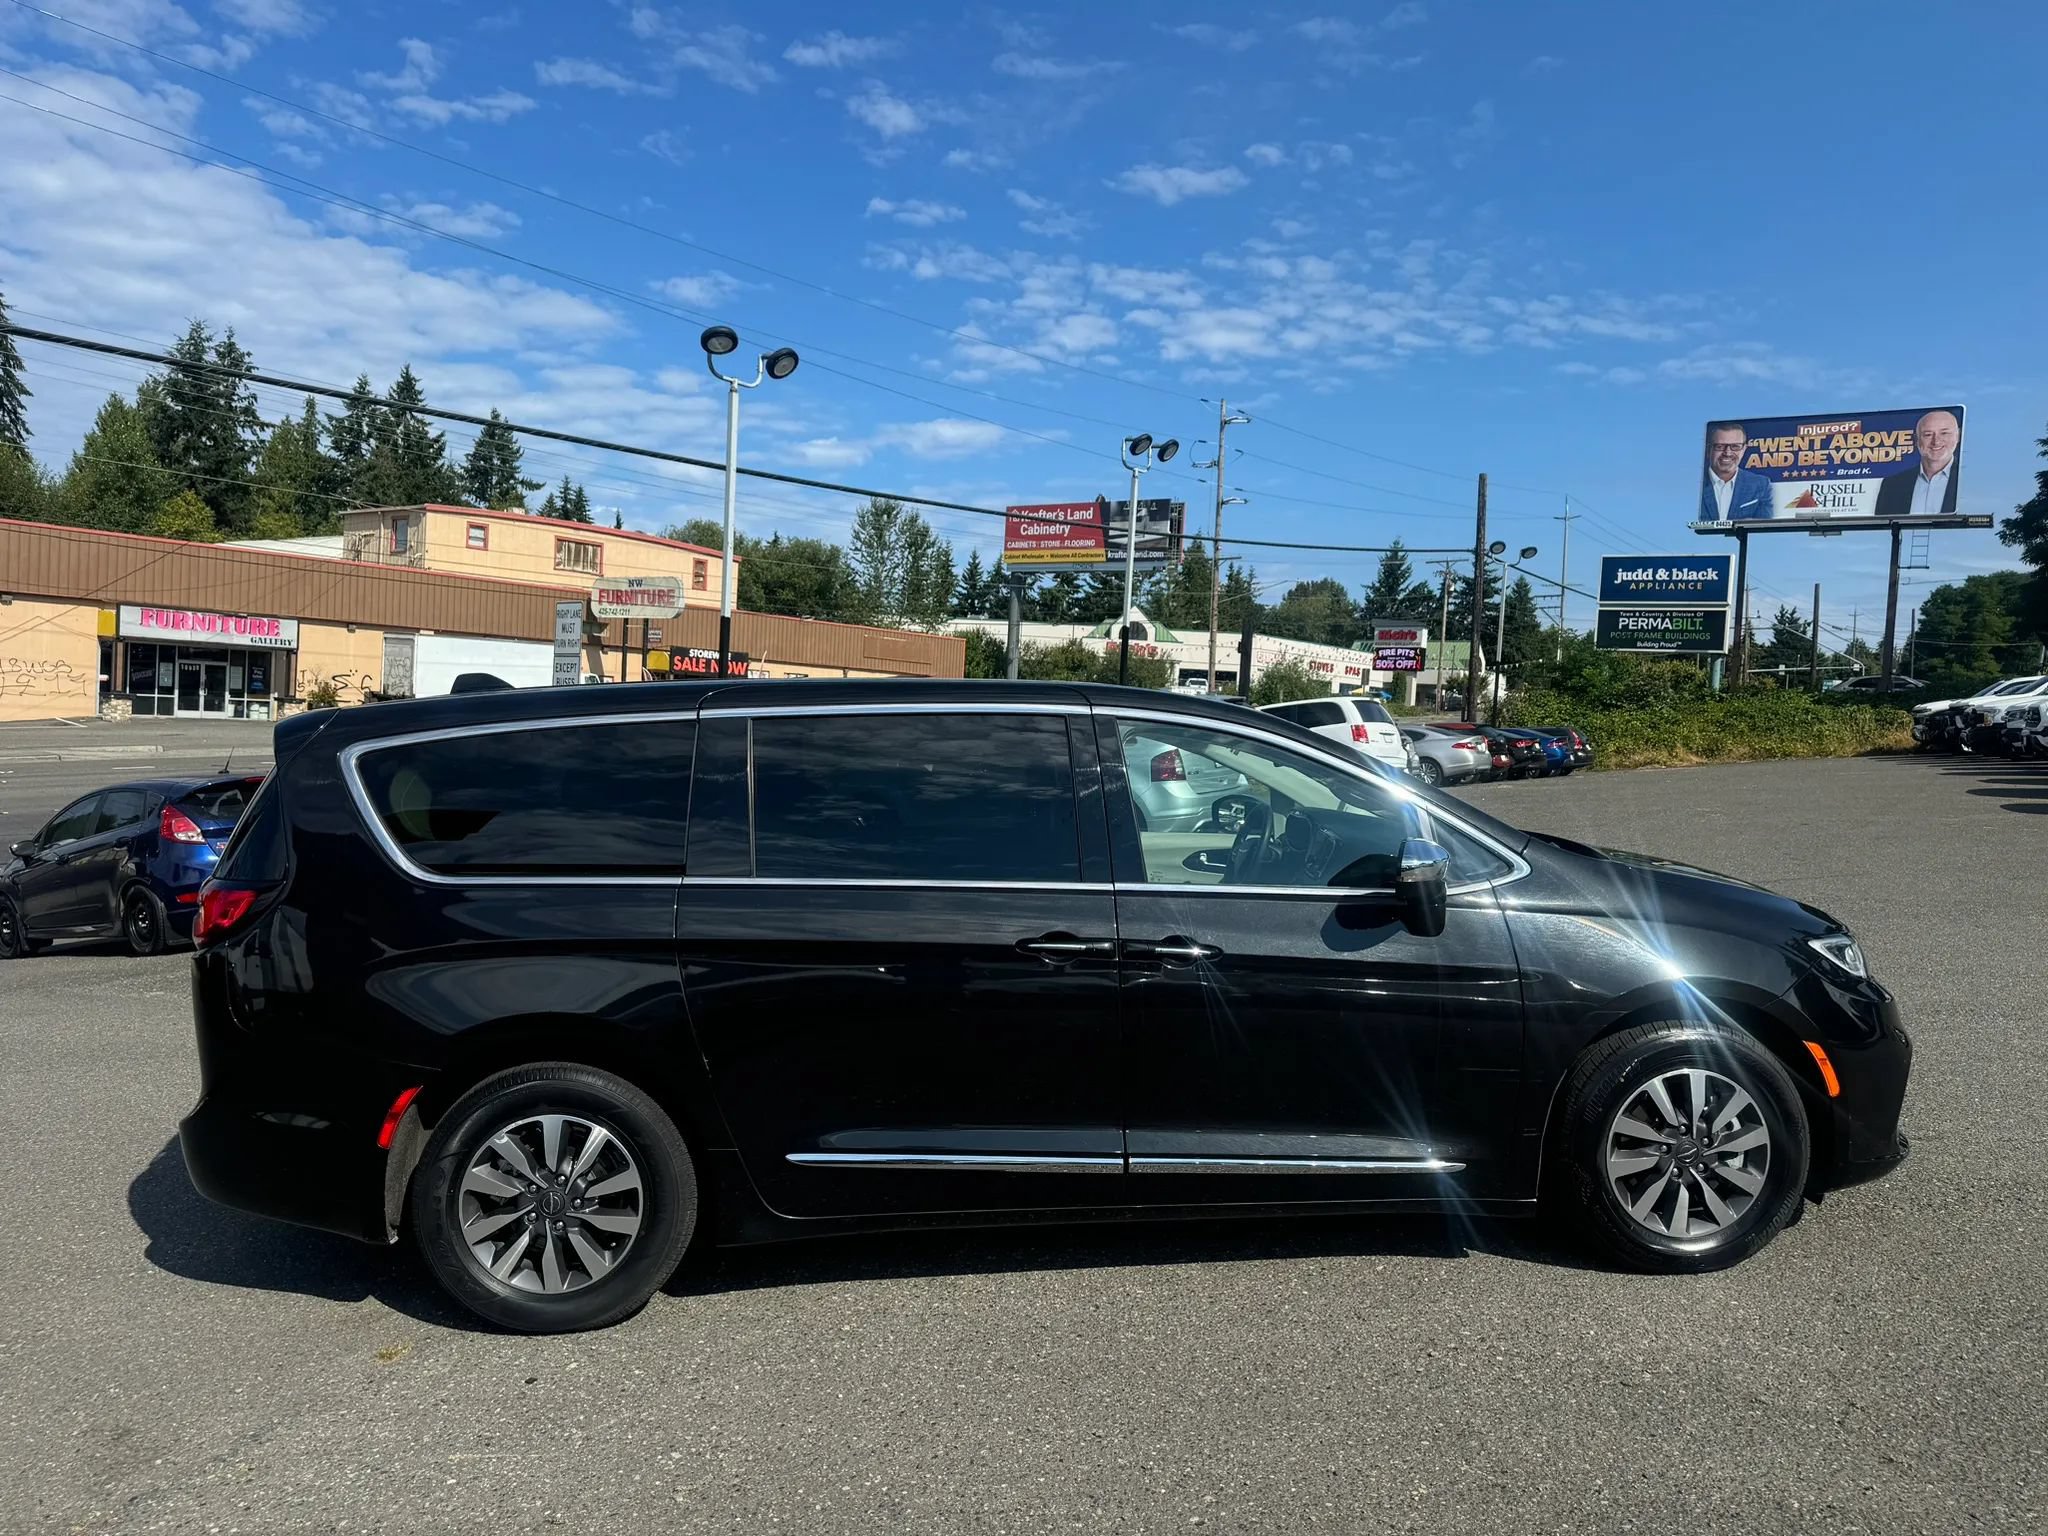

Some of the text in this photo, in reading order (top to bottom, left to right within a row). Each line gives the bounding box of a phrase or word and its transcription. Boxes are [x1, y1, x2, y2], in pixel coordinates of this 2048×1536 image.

[1800, 422, 1859, 437] Injured?
[1829, 430, 1914, 448] ABOVE
[1745, 451, 1794, 469] AND
[1837, 468, 1861, 476] Brad
[1862, 467, 1872, 475] K.
[1810, 483, 1866, 496] RUSSELL
[1067, 507, 1094, 520] Land
[1020, 523, 1071, 537] Cabinetry
[1040, 540, 1060, 548] STONE
[1064, 539, 1096, 547] FLOORING
[1614, 568, 1719, 584] judd & black
[628, 579, 643, 587] NW
[1629, 582, 1703, 590] APPLIANCE
[598, 588, 676, 605] FURNITURE
[570, 609, 582, 619] LANE
[140, 607, 281, 638] FURNITURE
[561, 623, 575, 634] MUST
[1610, 631, 1632, 639] POST
[1665, 632, 1711, 640] BUILDINGS
[250, 637, 294, 647] GALLERY
[567, 639, 580, 648] RIGHT
[1378, 648, 1416, 657] FIRE PITS
[555, 663, 577, 673] EXCEPT
[673, 655, 706, 673] SALE
[1309, 660, 1335, 673] STOVES
[1376, 660, 1417, 669] 50% OFF!
[1344, 665, 1361, 677] SPAS
